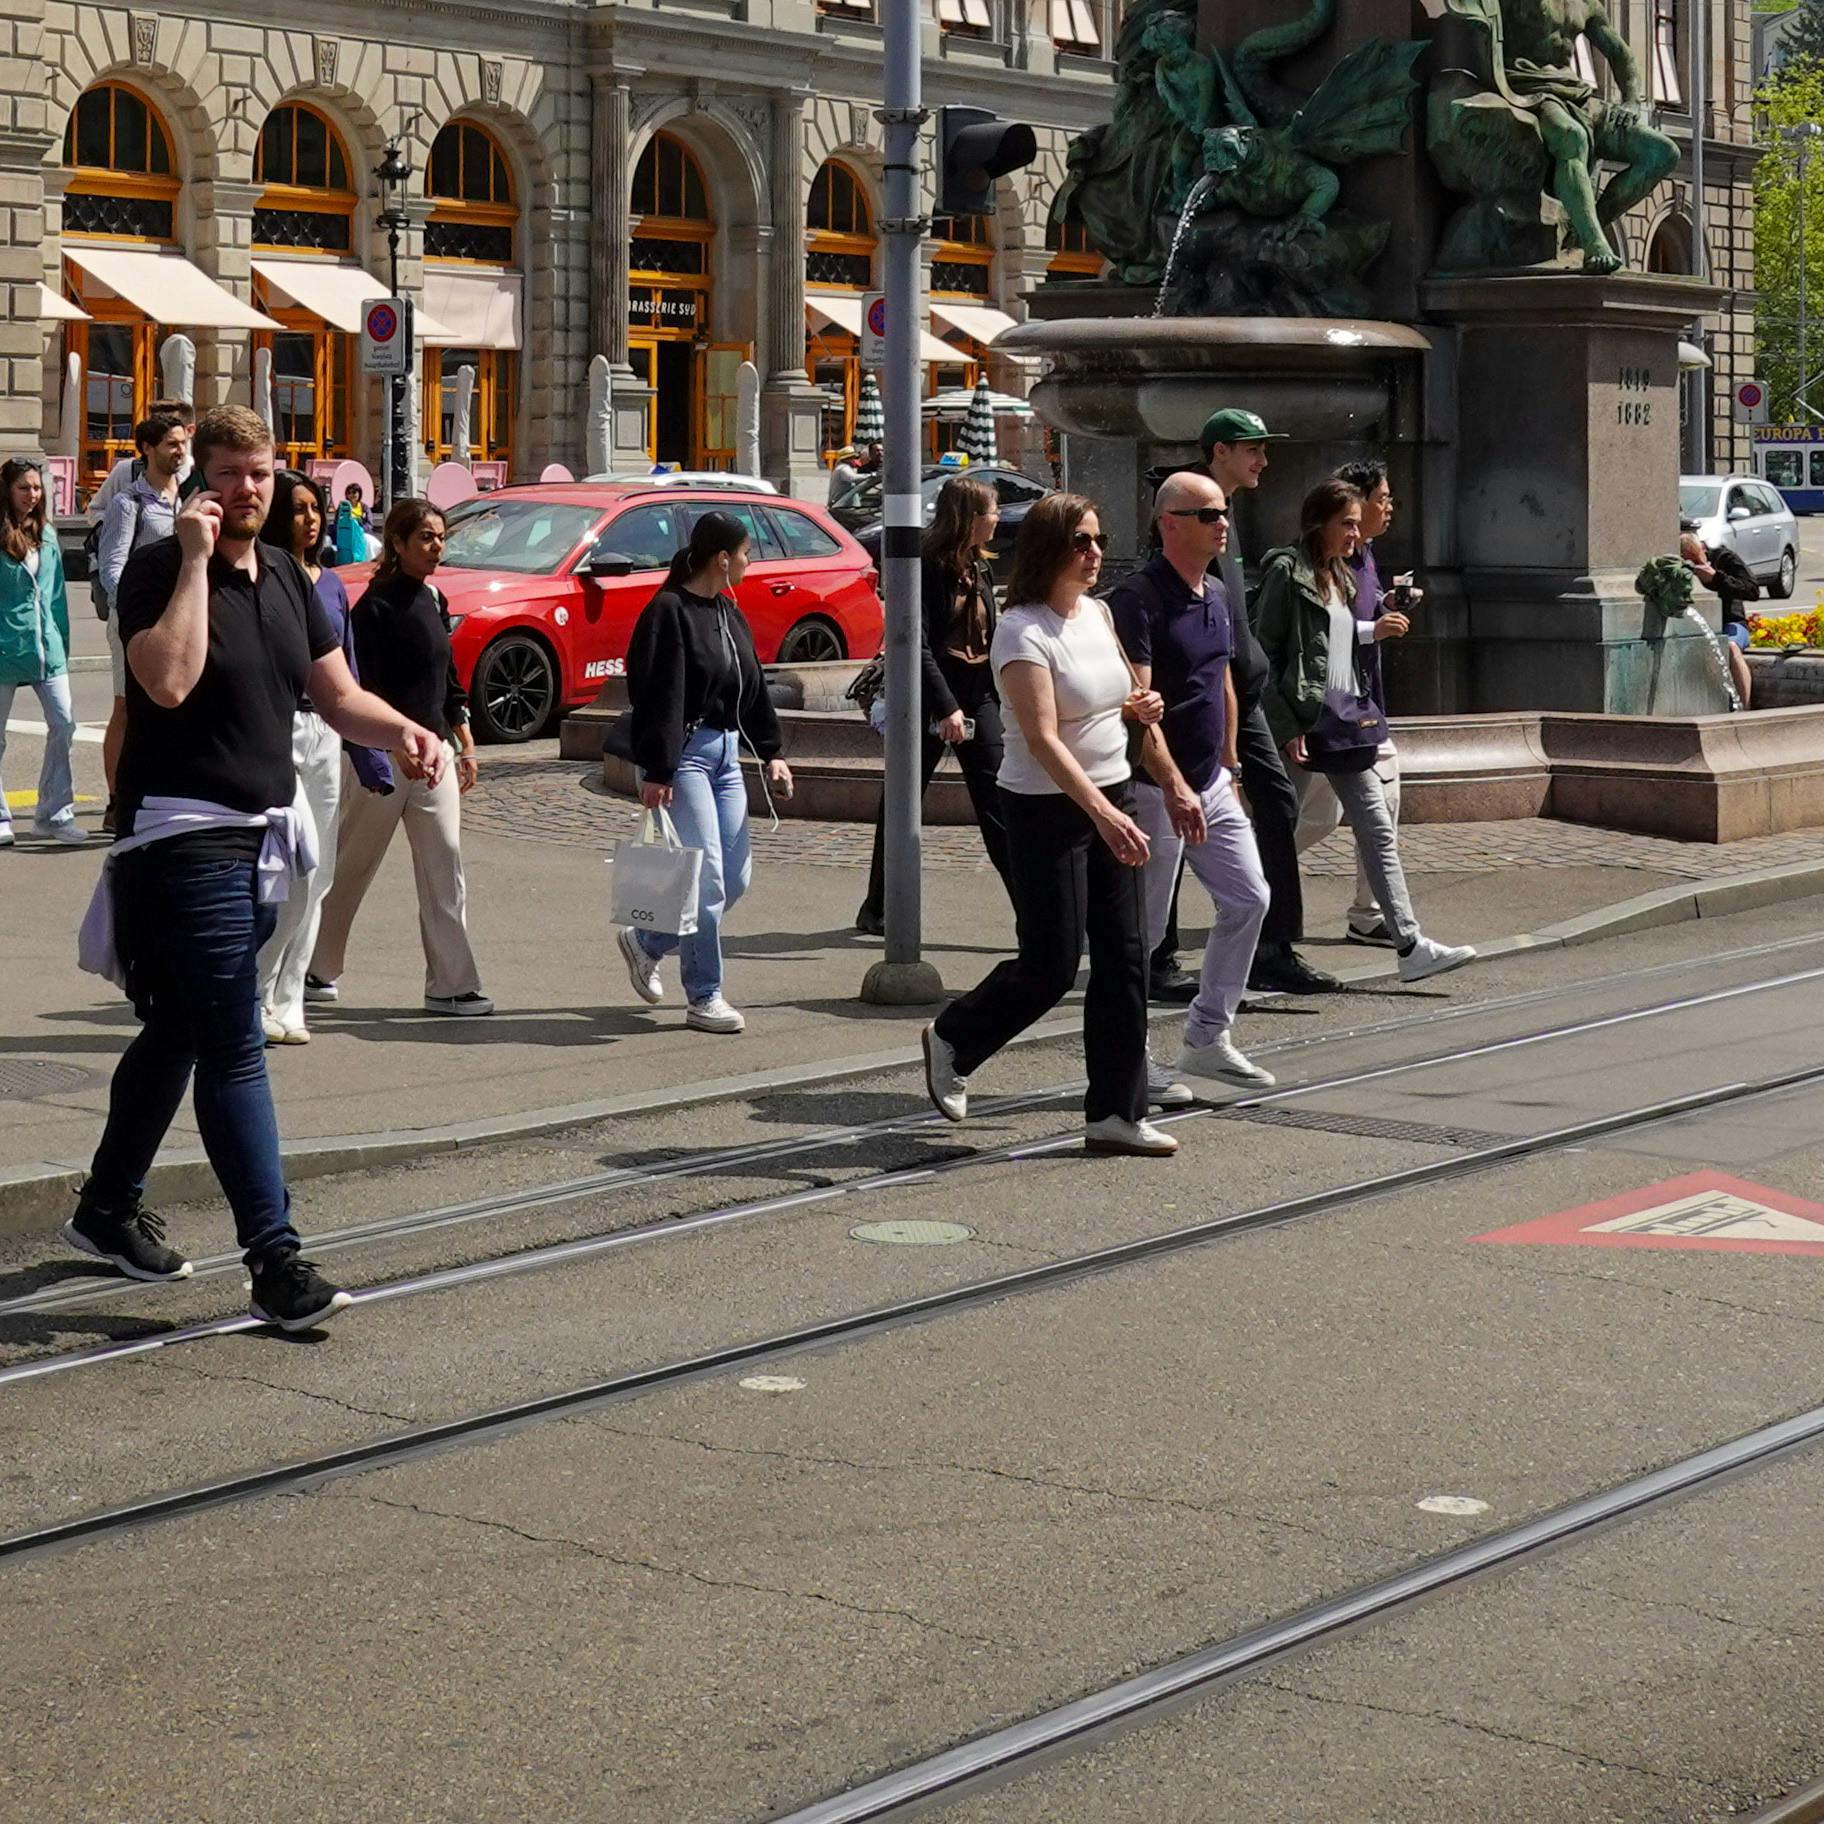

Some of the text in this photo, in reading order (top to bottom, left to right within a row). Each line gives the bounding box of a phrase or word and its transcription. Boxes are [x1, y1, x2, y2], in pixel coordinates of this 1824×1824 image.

[1754, 426, 1813, 441] EUROPA
[585, 657, 624, 679] HESS
[631, 909, 655, 922] COS
